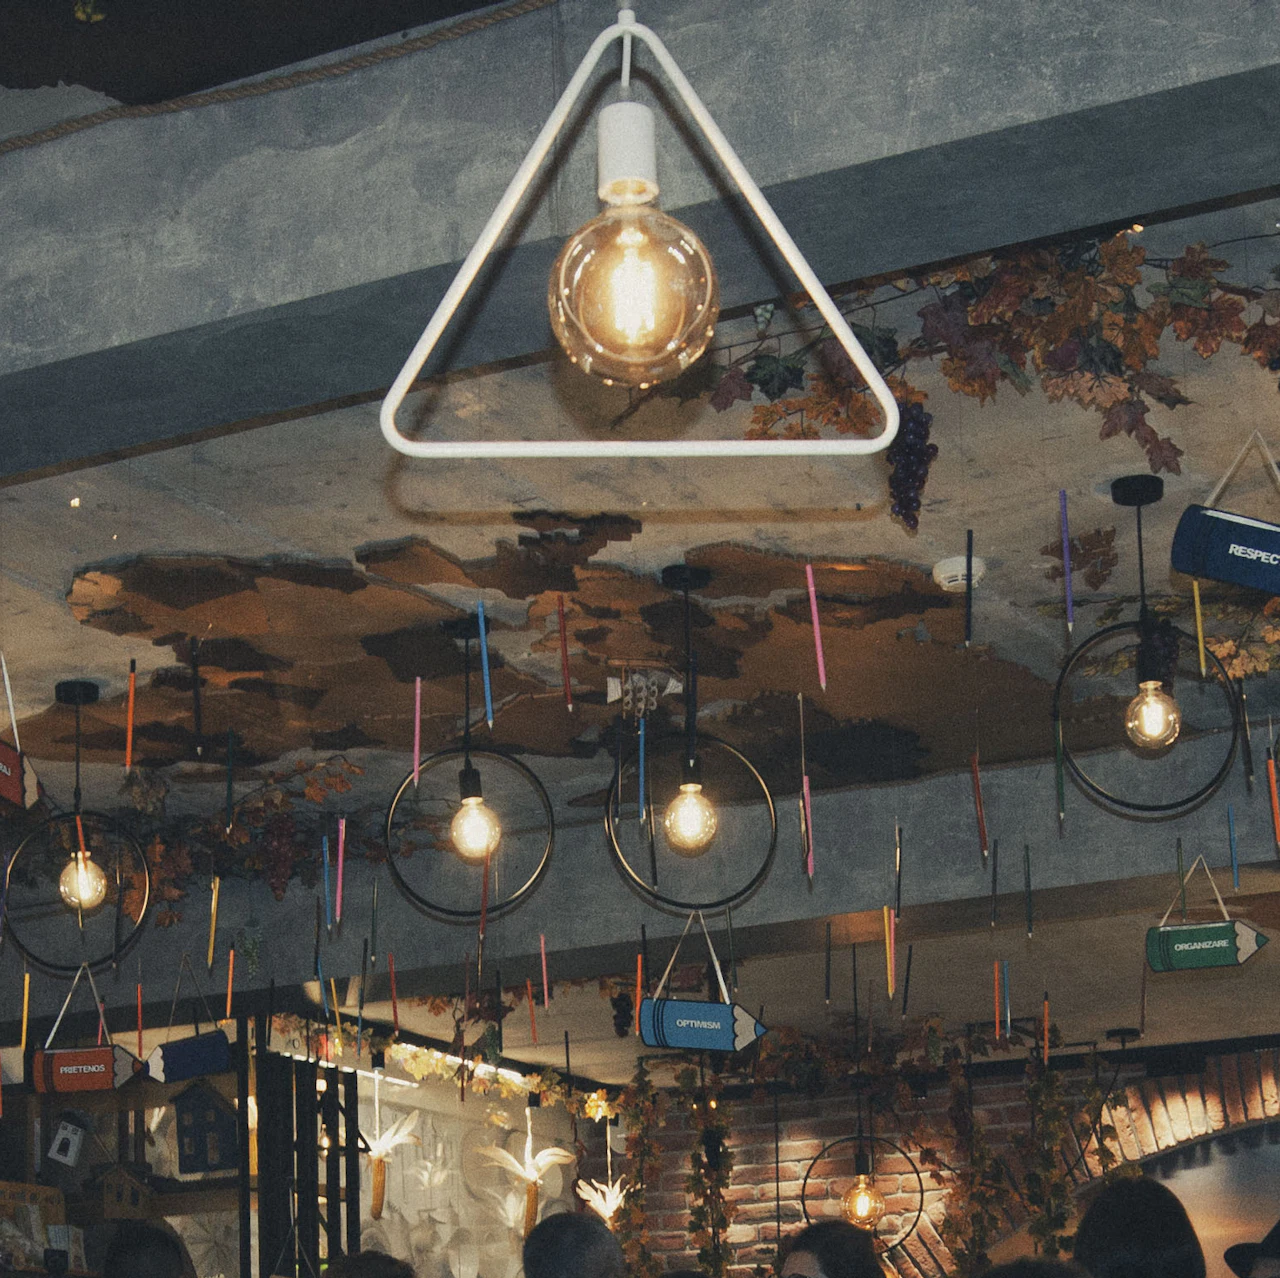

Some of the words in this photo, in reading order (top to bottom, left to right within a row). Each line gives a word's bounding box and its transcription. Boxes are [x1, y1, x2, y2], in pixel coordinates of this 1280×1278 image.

[1174, 939, 1229, 951] ORGANIZARE
[675, 1018, 721, 1030] OPTIMISM
[59, 1063, 106, 1075] PRIETENOS
